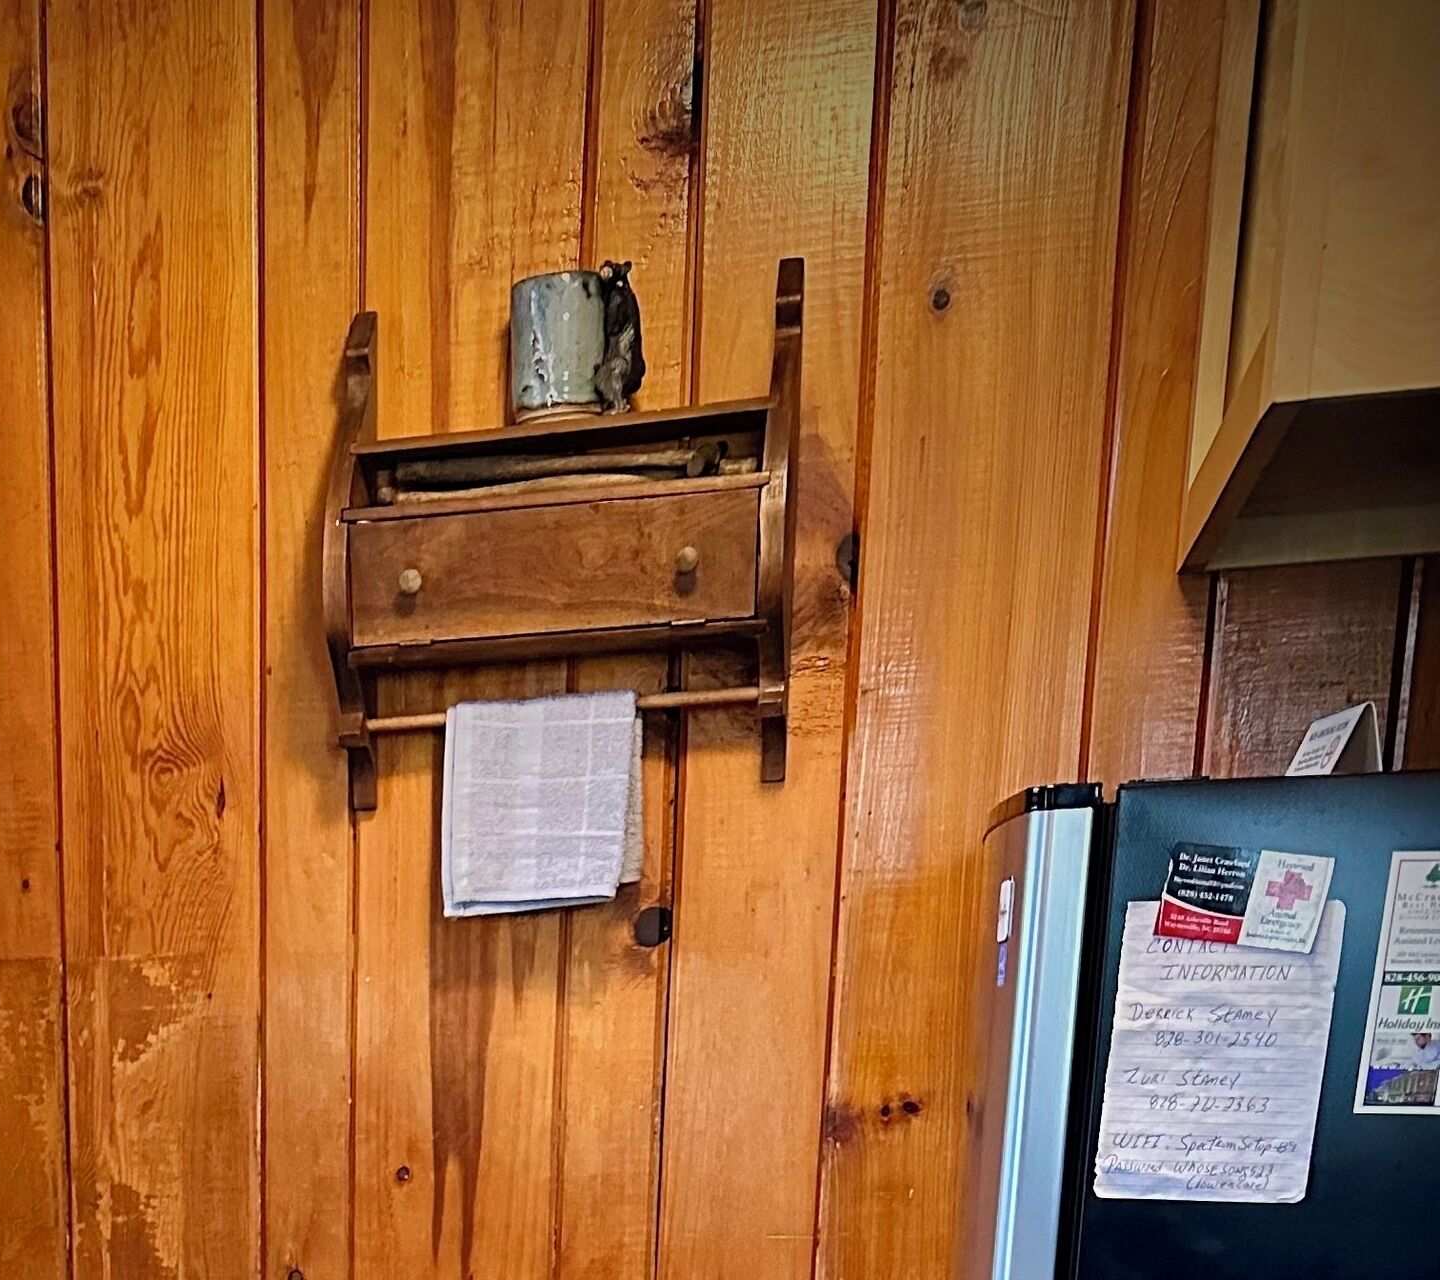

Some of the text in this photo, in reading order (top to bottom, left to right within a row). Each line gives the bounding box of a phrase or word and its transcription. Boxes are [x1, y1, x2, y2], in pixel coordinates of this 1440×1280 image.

[1179, 853, 1192, 862] Dr.
[1179, 863, 1192, 872] Dr.
[1160, 964, 1292, 982] INFORMATION
[1378, 1017, 1424, 1031] Holiday
